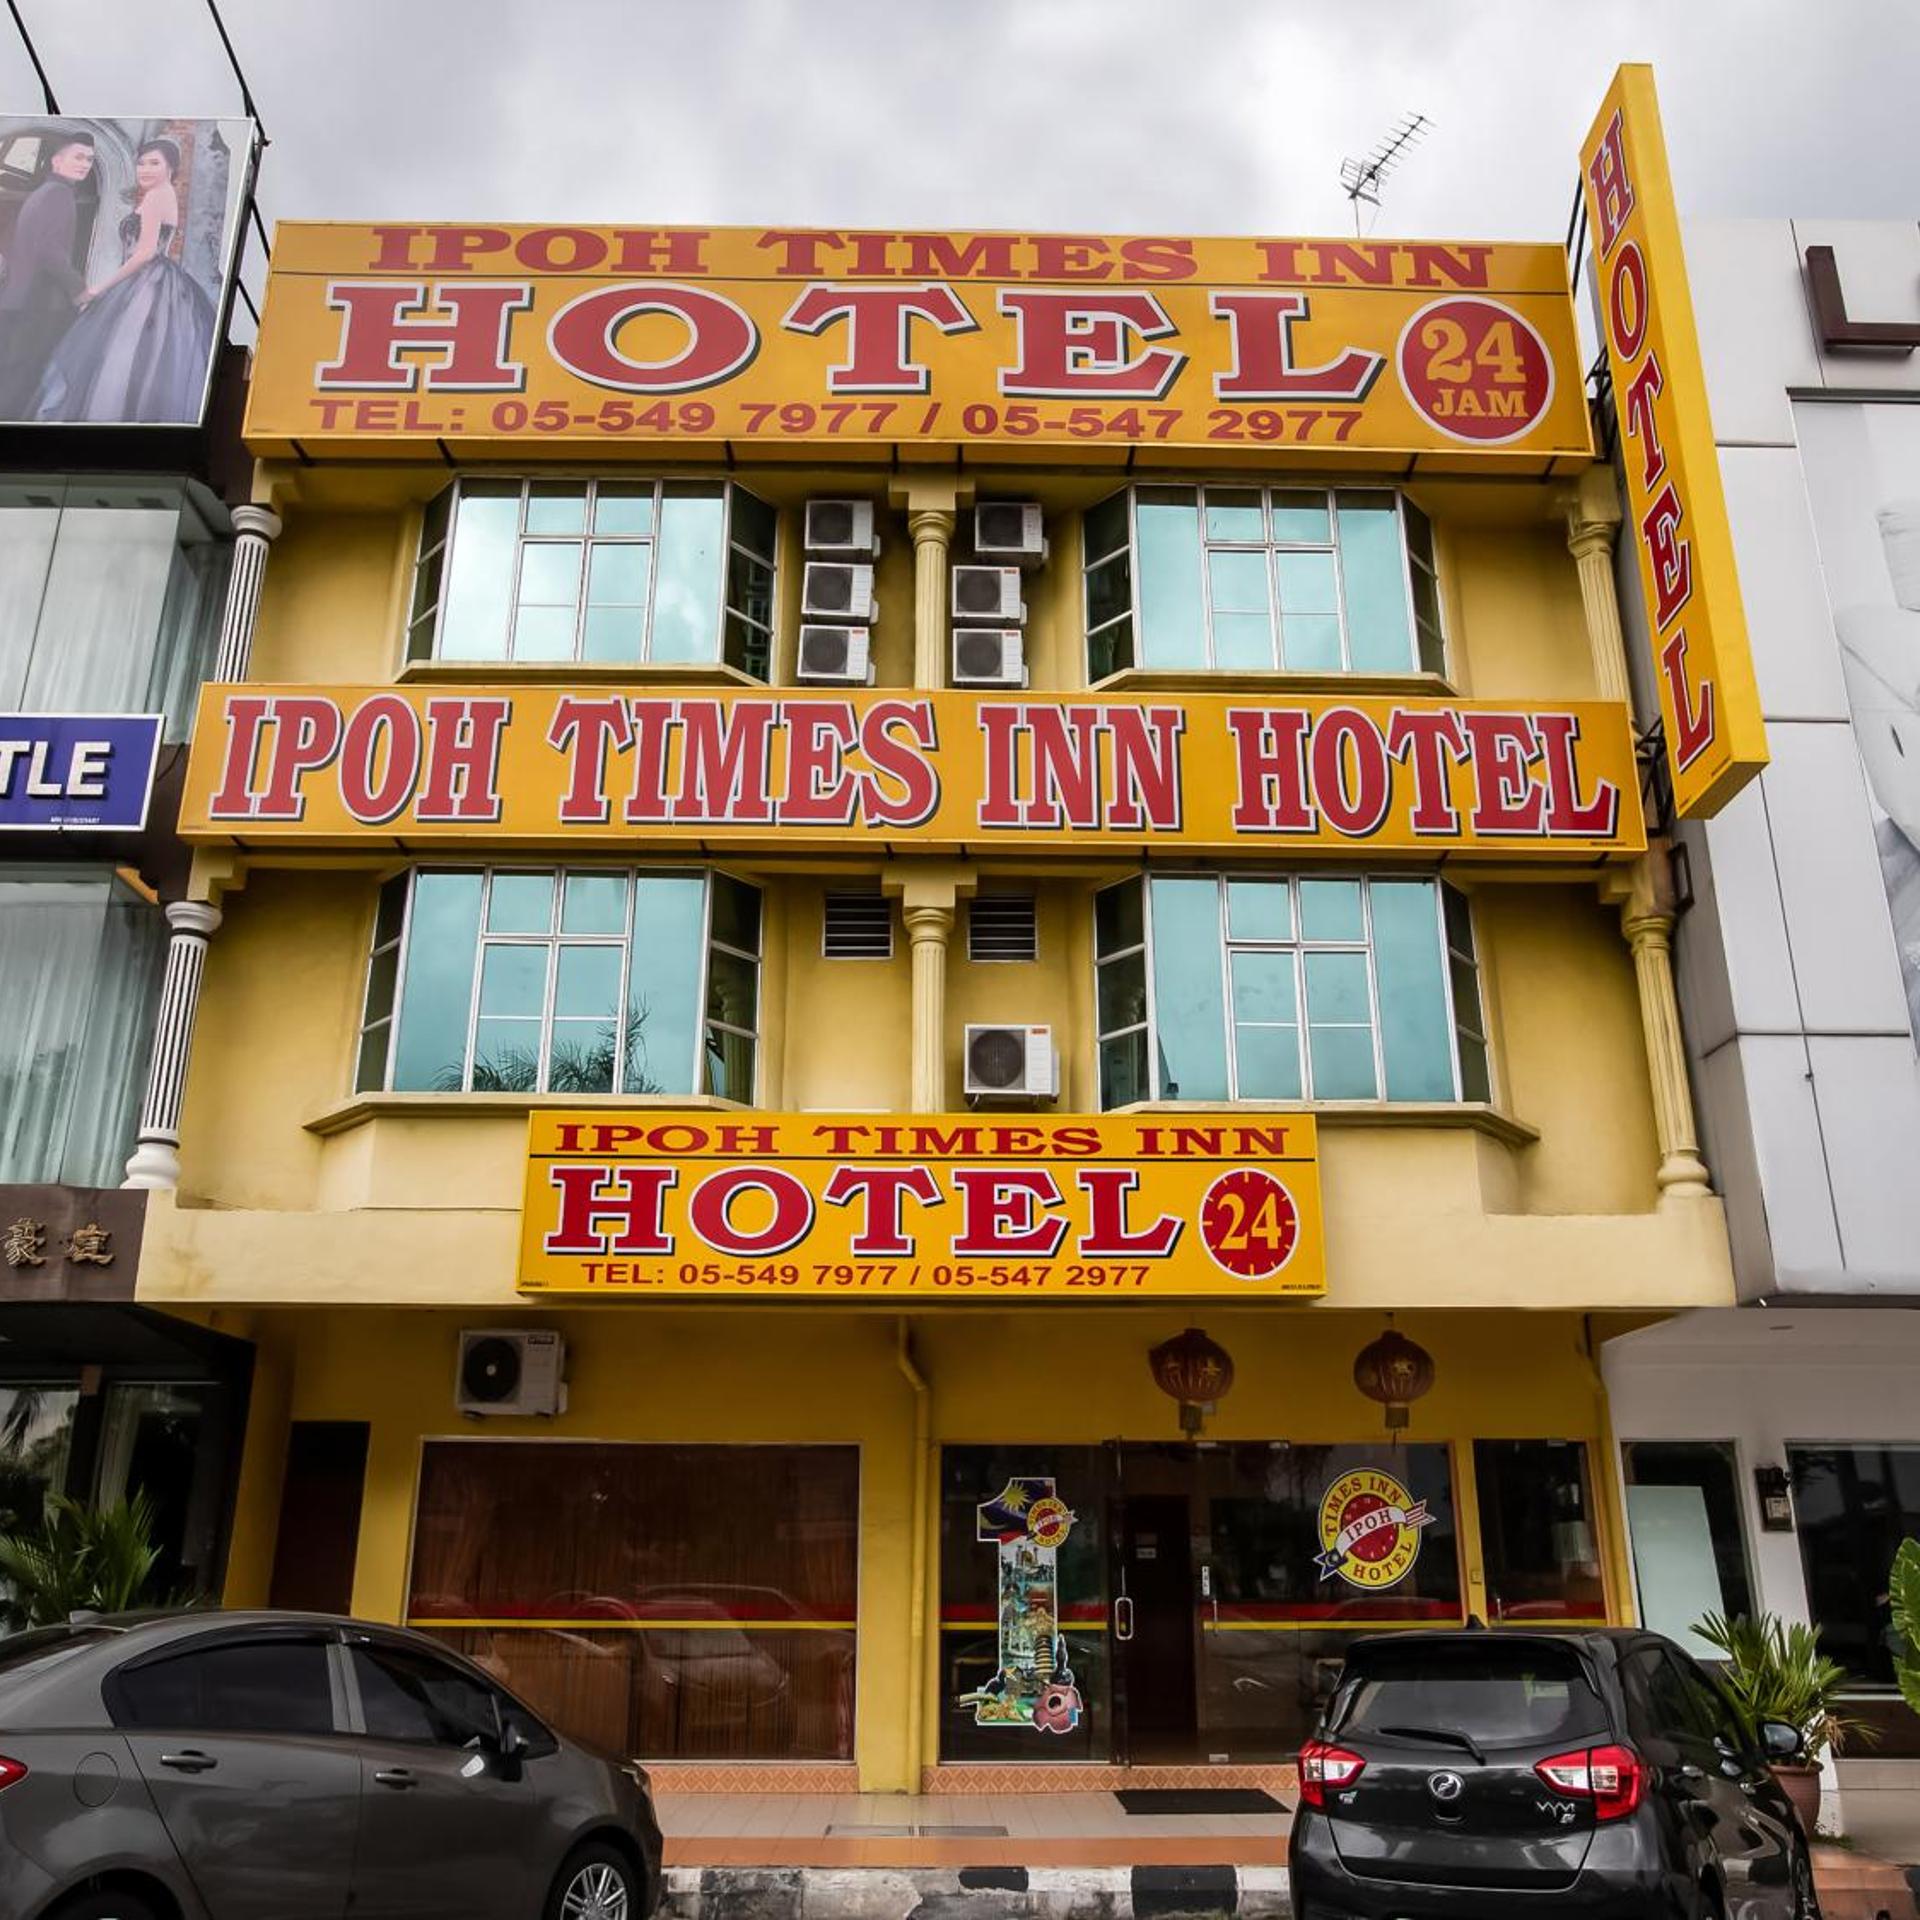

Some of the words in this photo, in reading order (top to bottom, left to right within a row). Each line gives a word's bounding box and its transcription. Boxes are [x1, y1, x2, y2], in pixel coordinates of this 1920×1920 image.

[368, 227, 710, 273] IPOH
[756, 230, 1198, 280] TIMES
[1255, 241, 1494, 288] INN
[315, 281, 1387, 403] HOTEL
[1421, 317, 1525, 384] 24
[310, 399, 465, 432] TEL:
[491, 400, 716, 434] 05-549
[740, 402, 898, 435] 7977
[962, 404, 1184, 439] 05-547
[1207, 408, 1364, 442] 2977
[1432, 390, 1528, 419] JAM
[1589, 106, 1714, 774] HOTEL
[208, 693, 513, 824] IPOH
[546, 694, 942, 828] TIMES
[977, 702, 1186, 833] INN
[1226, 705, 1620, 839] HOTEL
[555, 1123, 780, 1154] IPOH
[813, 1125, 1103, 1155] TIMES
[1135, 1127, 1290, 1156] INN
[544, 1164, 1186, 1260] HOTEL
[1217, 1191, 1282, 1251] 24
[581, 1262, 664, 1285] TEL:
[679, 1263, 799, 1286] 05-549
[813, 1264, 898, 1286] 7977
[932, 1265, 1053, 1287] 05-547
[1066, 1265, 1151, 1287] 2977
[1324, 1477, 1363, 1538] TIMES
[1369, 1476, 1403, 1502] INN
[1345, 1508, 1393, 1542] IPOH
[1353, 1541, 1412, 1581] HOTEL
